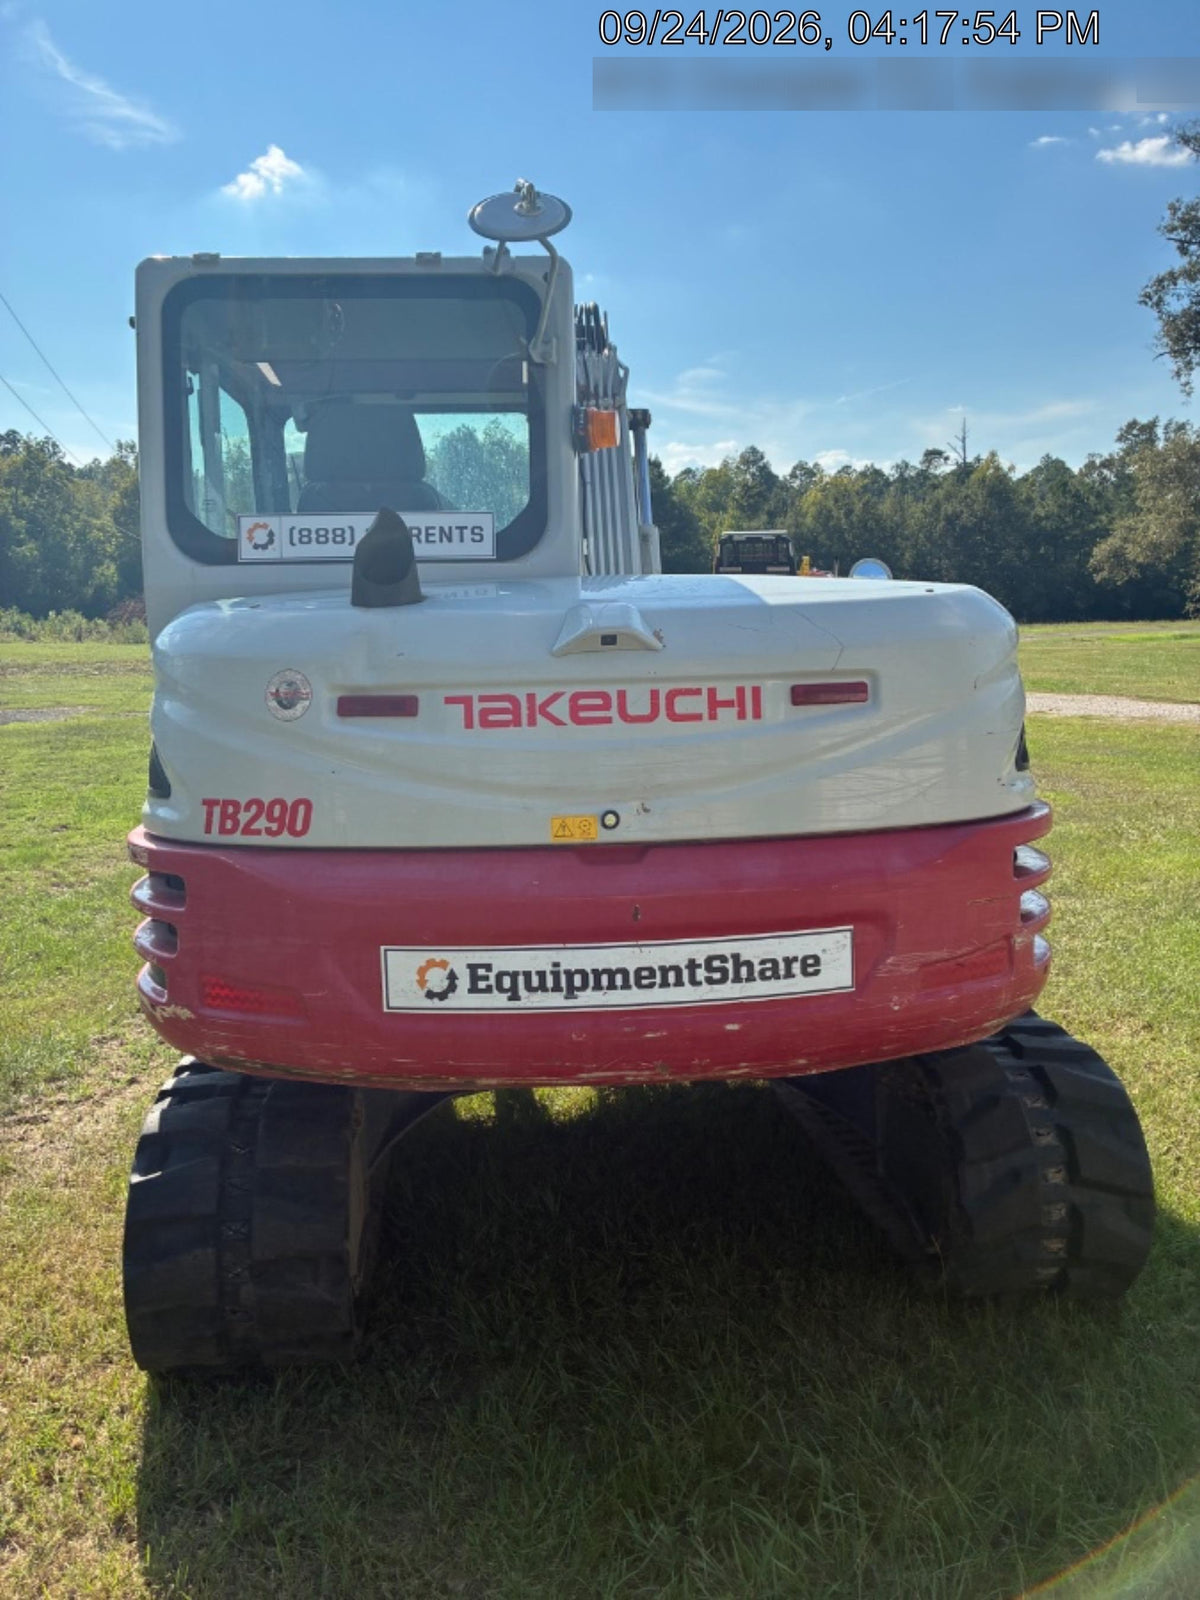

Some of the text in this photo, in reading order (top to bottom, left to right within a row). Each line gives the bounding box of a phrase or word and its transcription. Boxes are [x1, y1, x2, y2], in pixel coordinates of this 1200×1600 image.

[289, 526, 355, 546] (888)
[202, 798, 313, 838] TB290
[466, 953, 822, 1000] EquipmentShare
